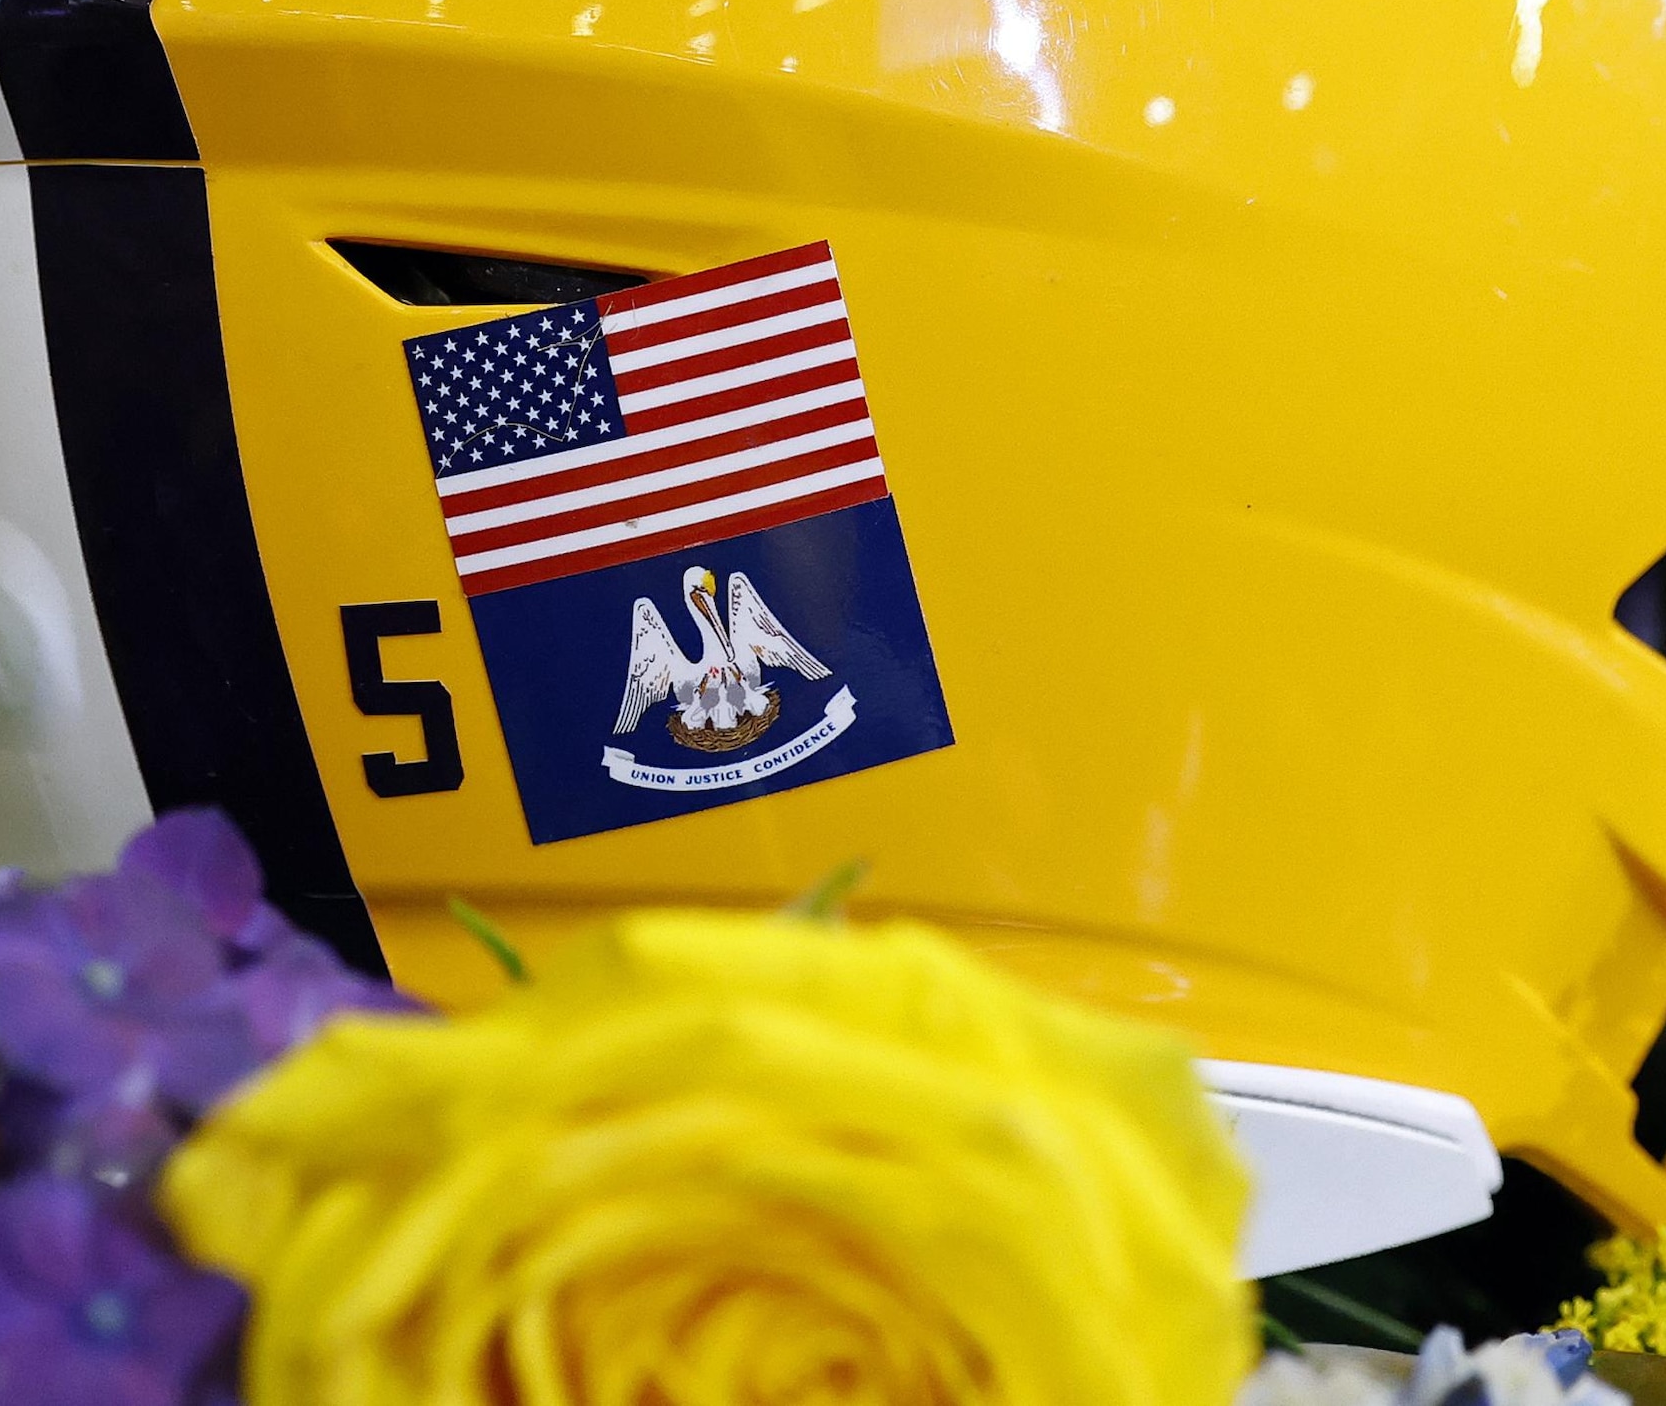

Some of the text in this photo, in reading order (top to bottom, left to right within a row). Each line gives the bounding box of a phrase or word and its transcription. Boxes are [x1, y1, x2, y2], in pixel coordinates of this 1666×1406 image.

[339, 600, 464, 798] 5
[631, 721, 836, 785] UNION JUSTICE CONFIDENCE
